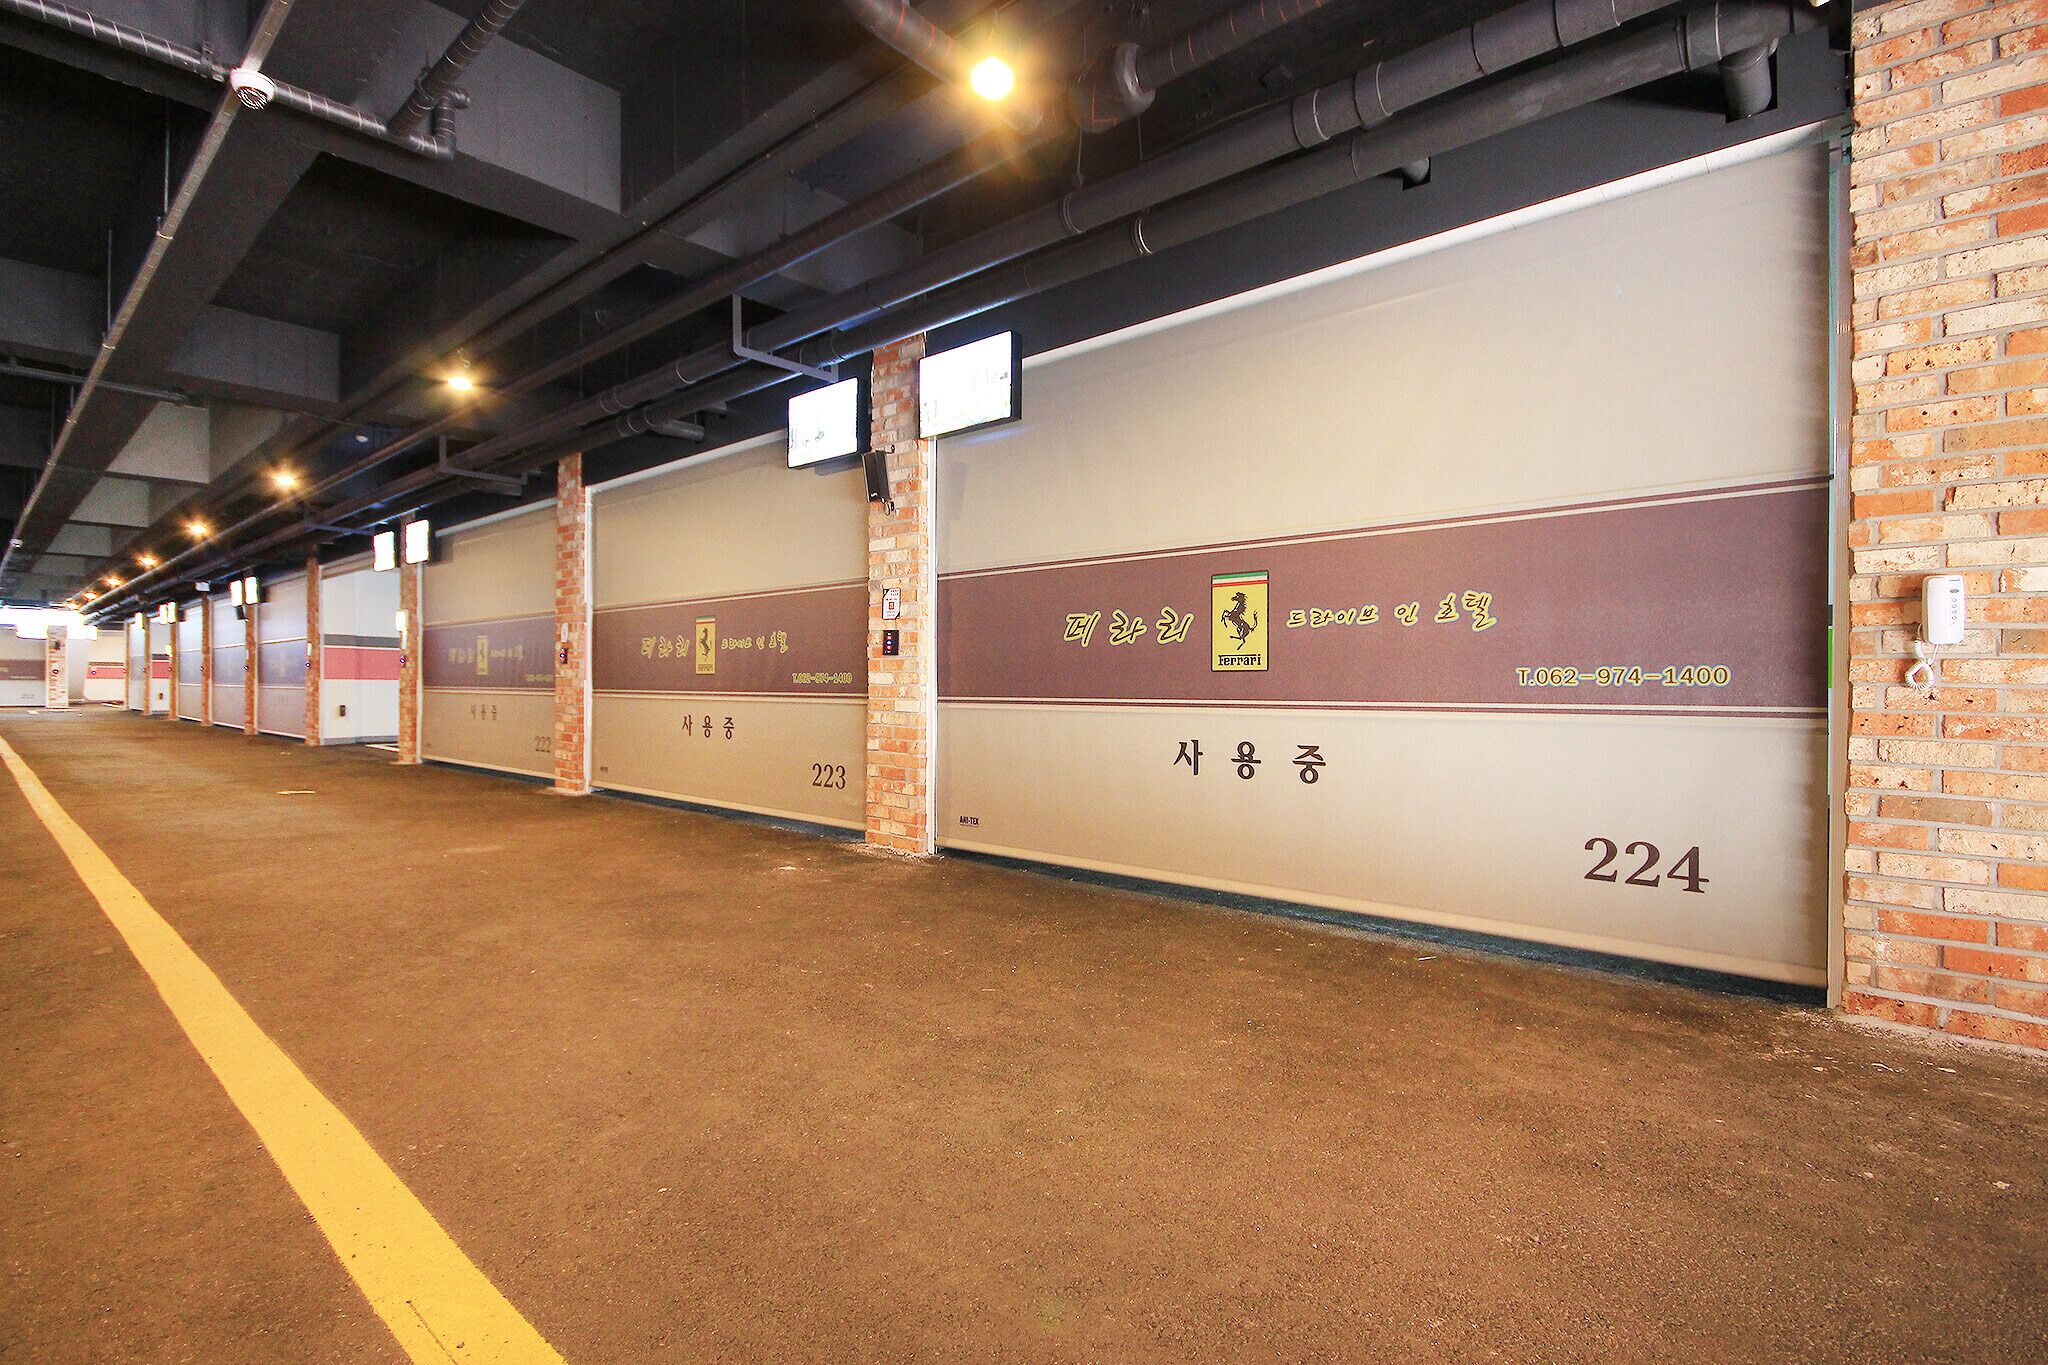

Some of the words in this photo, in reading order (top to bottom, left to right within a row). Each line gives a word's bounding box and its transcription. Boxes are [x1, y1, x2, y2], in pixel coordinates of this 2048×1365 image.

[1286, 604, 1380, 629] 드라이브
[1394, 601, 1420, 627] 인
[1433, 589, 1498, 632] 호텔
[1217, 653, 1262, 666] Ferrari
[1516, 665, 1731, 688] T.062-974-1400
[812, 763, 846, 790] 223
[1584, 837, 1710, 894] 224
